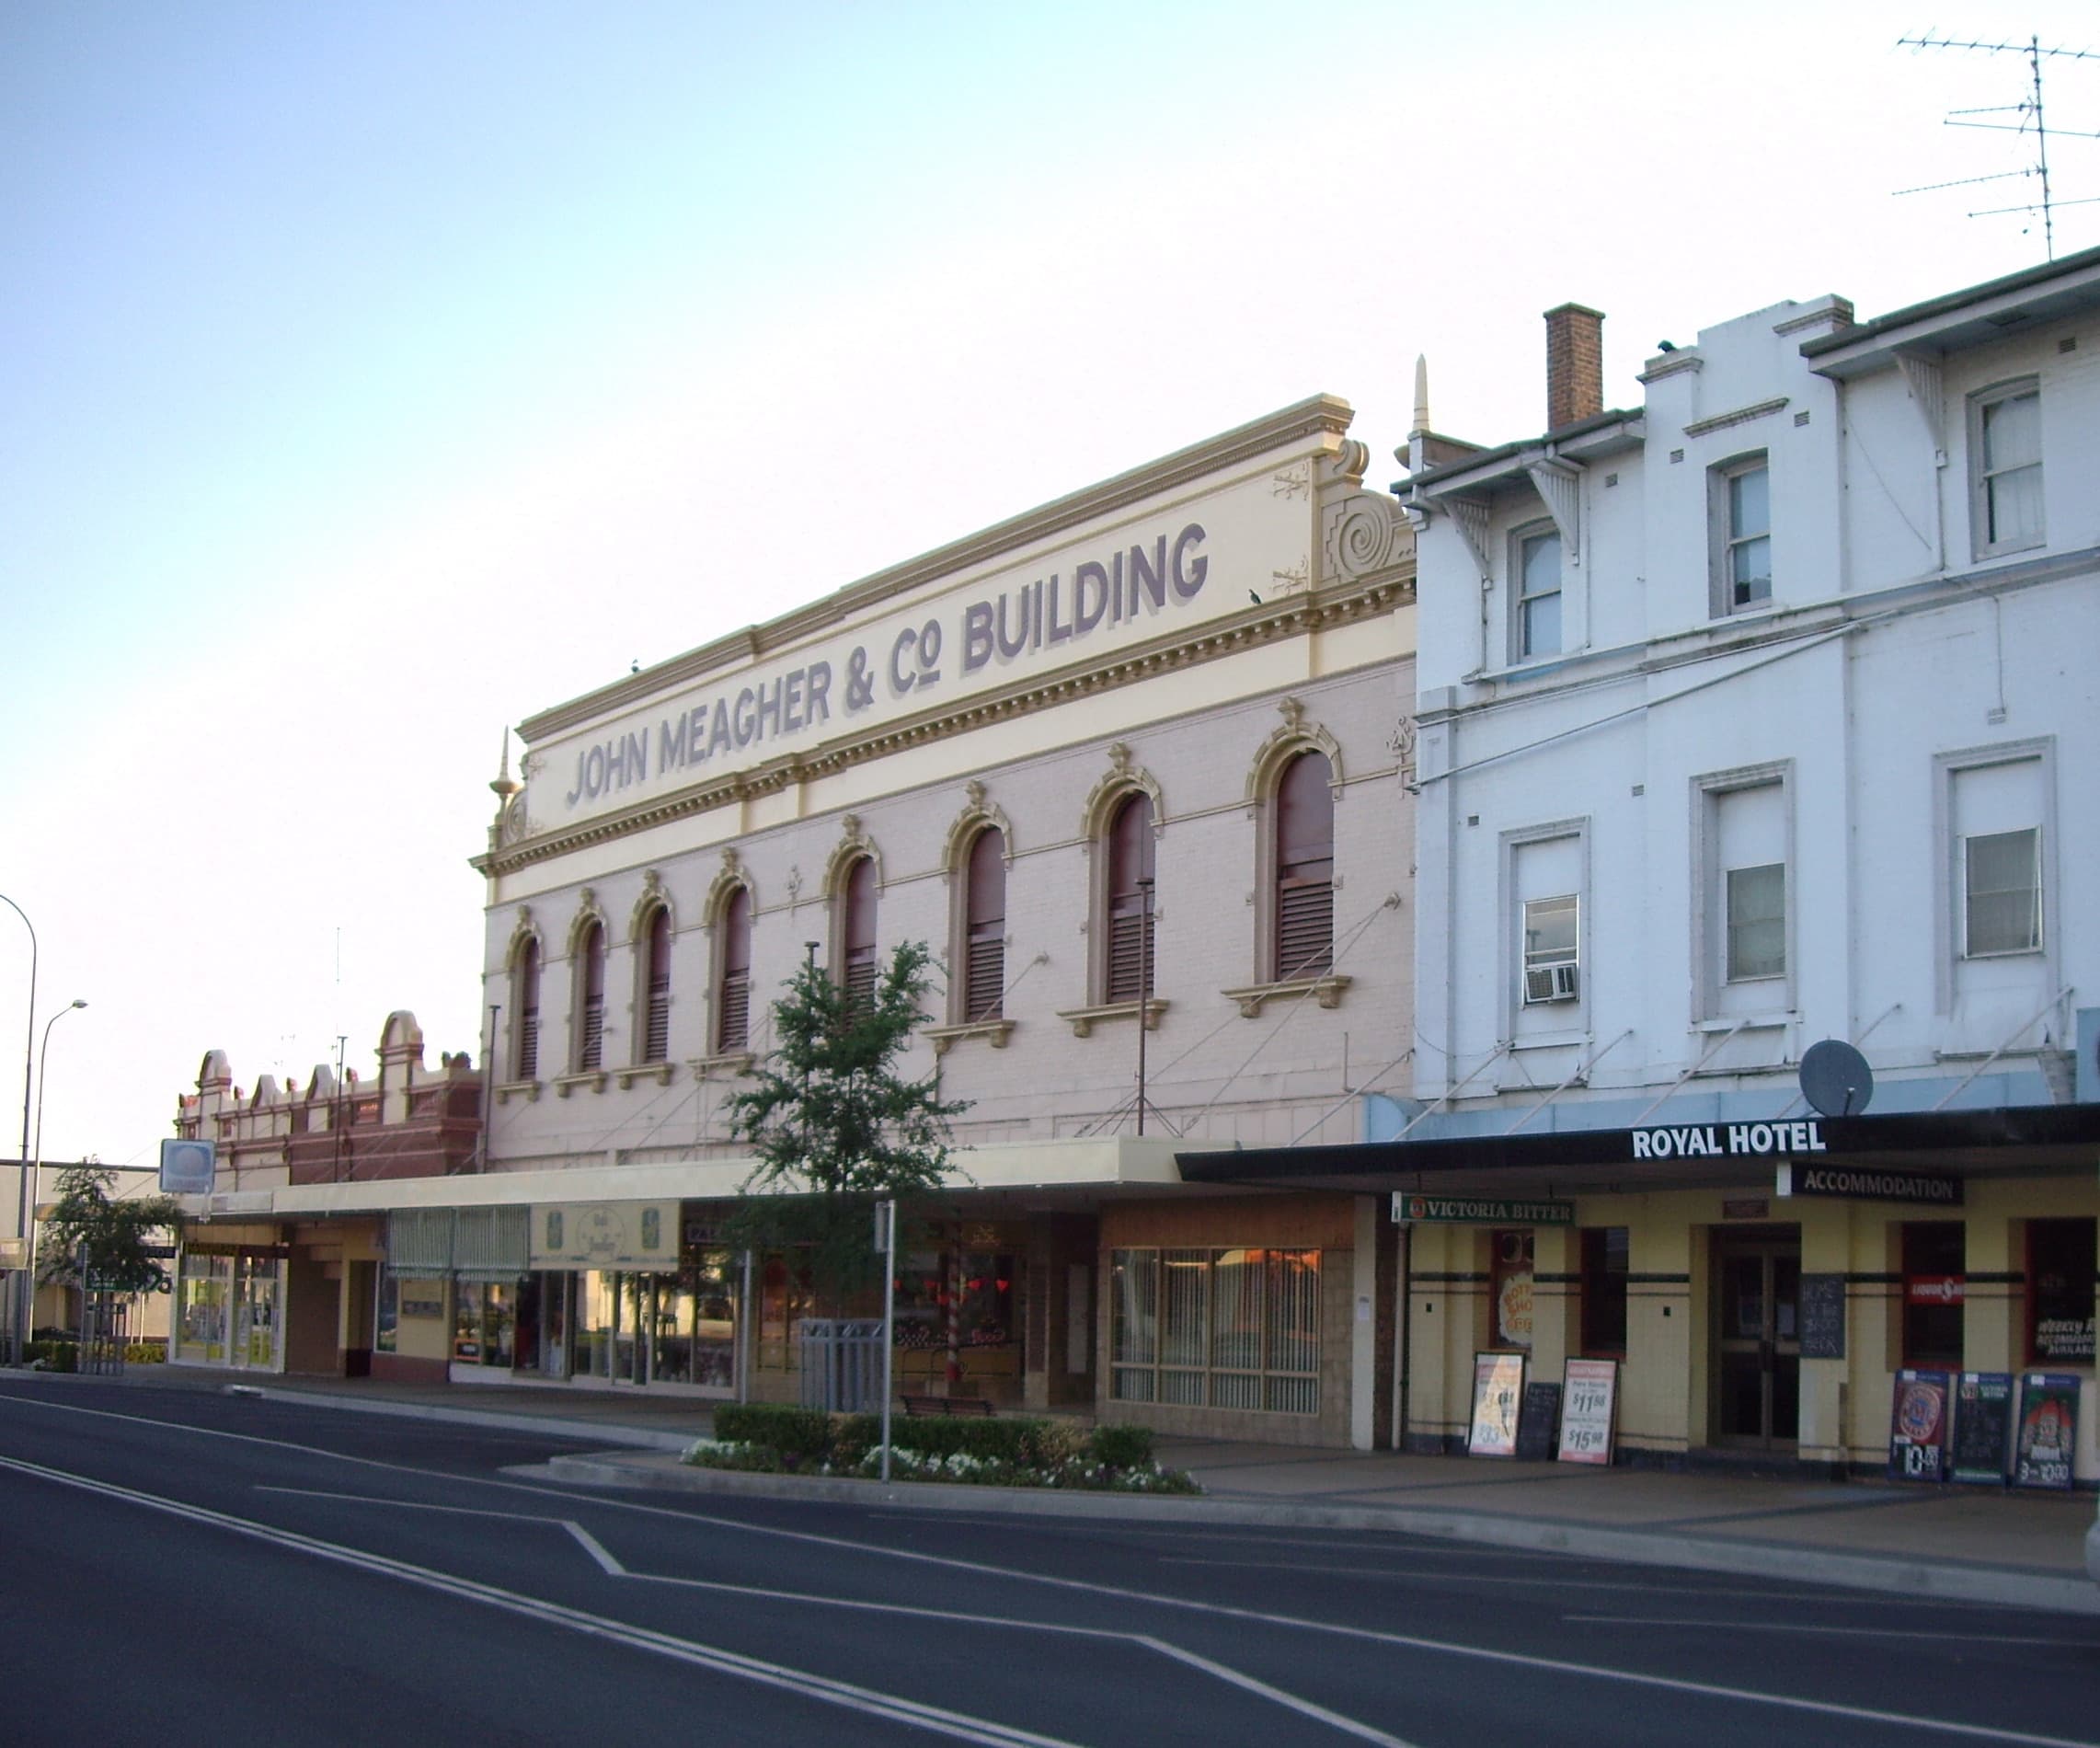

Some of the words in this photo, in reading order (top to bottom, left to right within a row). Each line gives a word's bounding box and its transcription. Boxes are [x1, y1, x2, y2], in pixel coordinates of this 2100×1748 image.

[566, 726, 648, 806] JOHN
[660, 660, 832, 774] MEAGHER
[846, 645, 875, 711] &
[963, 522, 1209, 672] BUILDING
[1632, 1127, 1723, 1158] ROYAL
[1728, 1121, 1827, 1154] HOTEL
[1804, 1169, 1954, 1200] ACCOMMODATION
[1426, 1201, 1508, 1218] VICTORIA
[1512, 1204, 1570, 1221] BITTER
